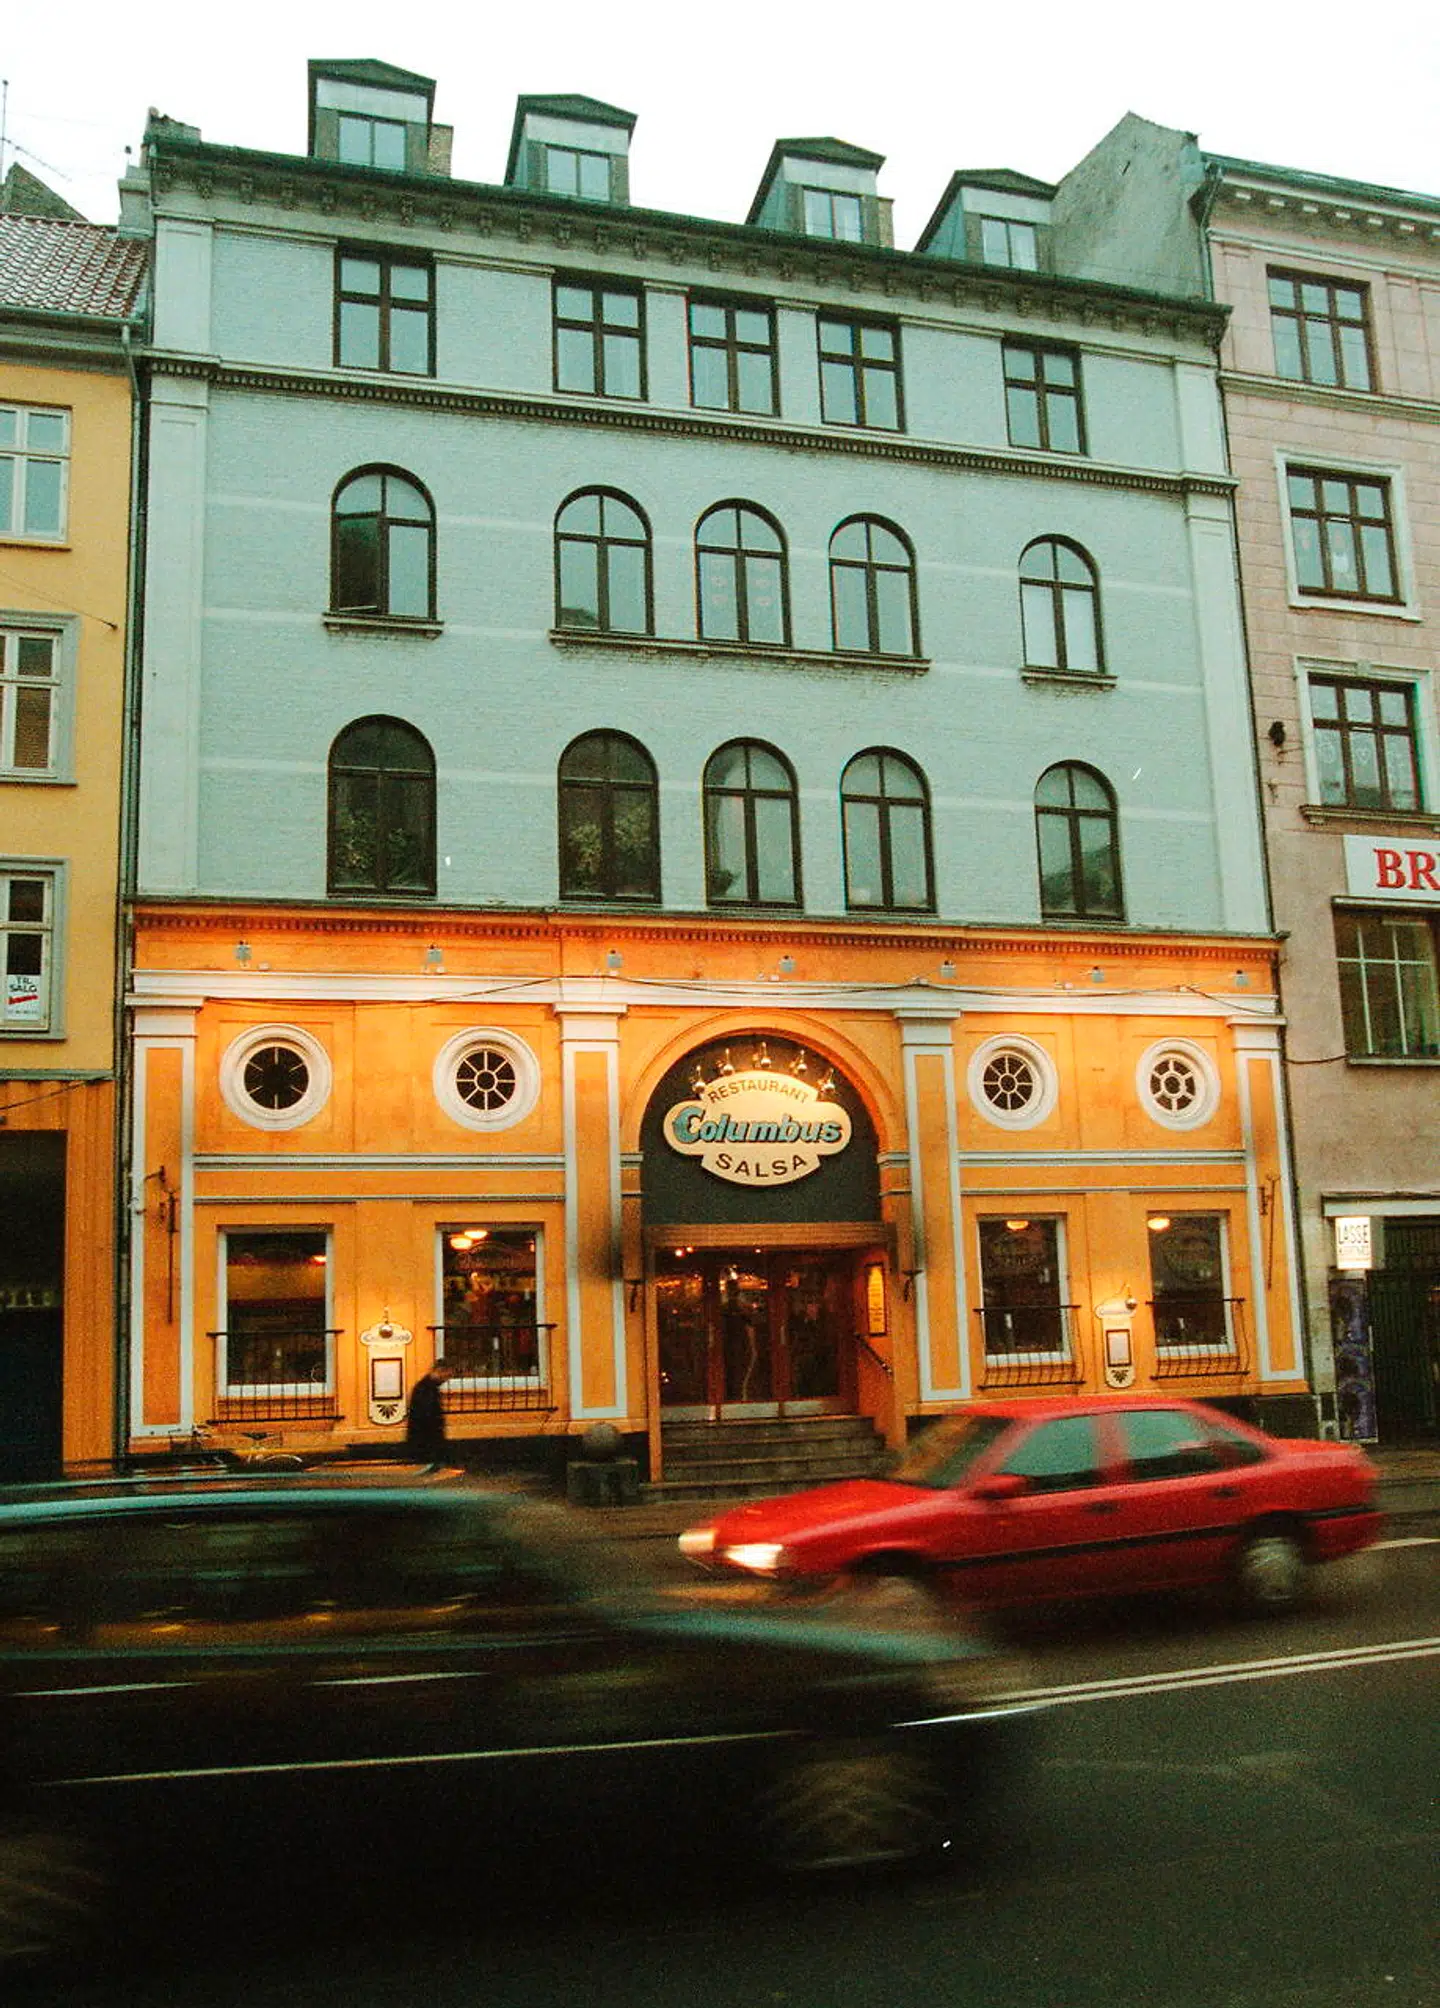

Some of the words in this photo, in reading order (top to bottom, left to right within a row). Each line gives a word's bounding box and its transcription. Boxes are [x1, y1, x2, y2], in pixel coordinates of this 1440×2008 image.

[1373, 848, 1440, 890] BR
[708, 1079, 808, 1103] RESTAURANT
[672, 1105, 843, 1144] Columbus
[716, 1153, 807, 1177] SALSA
